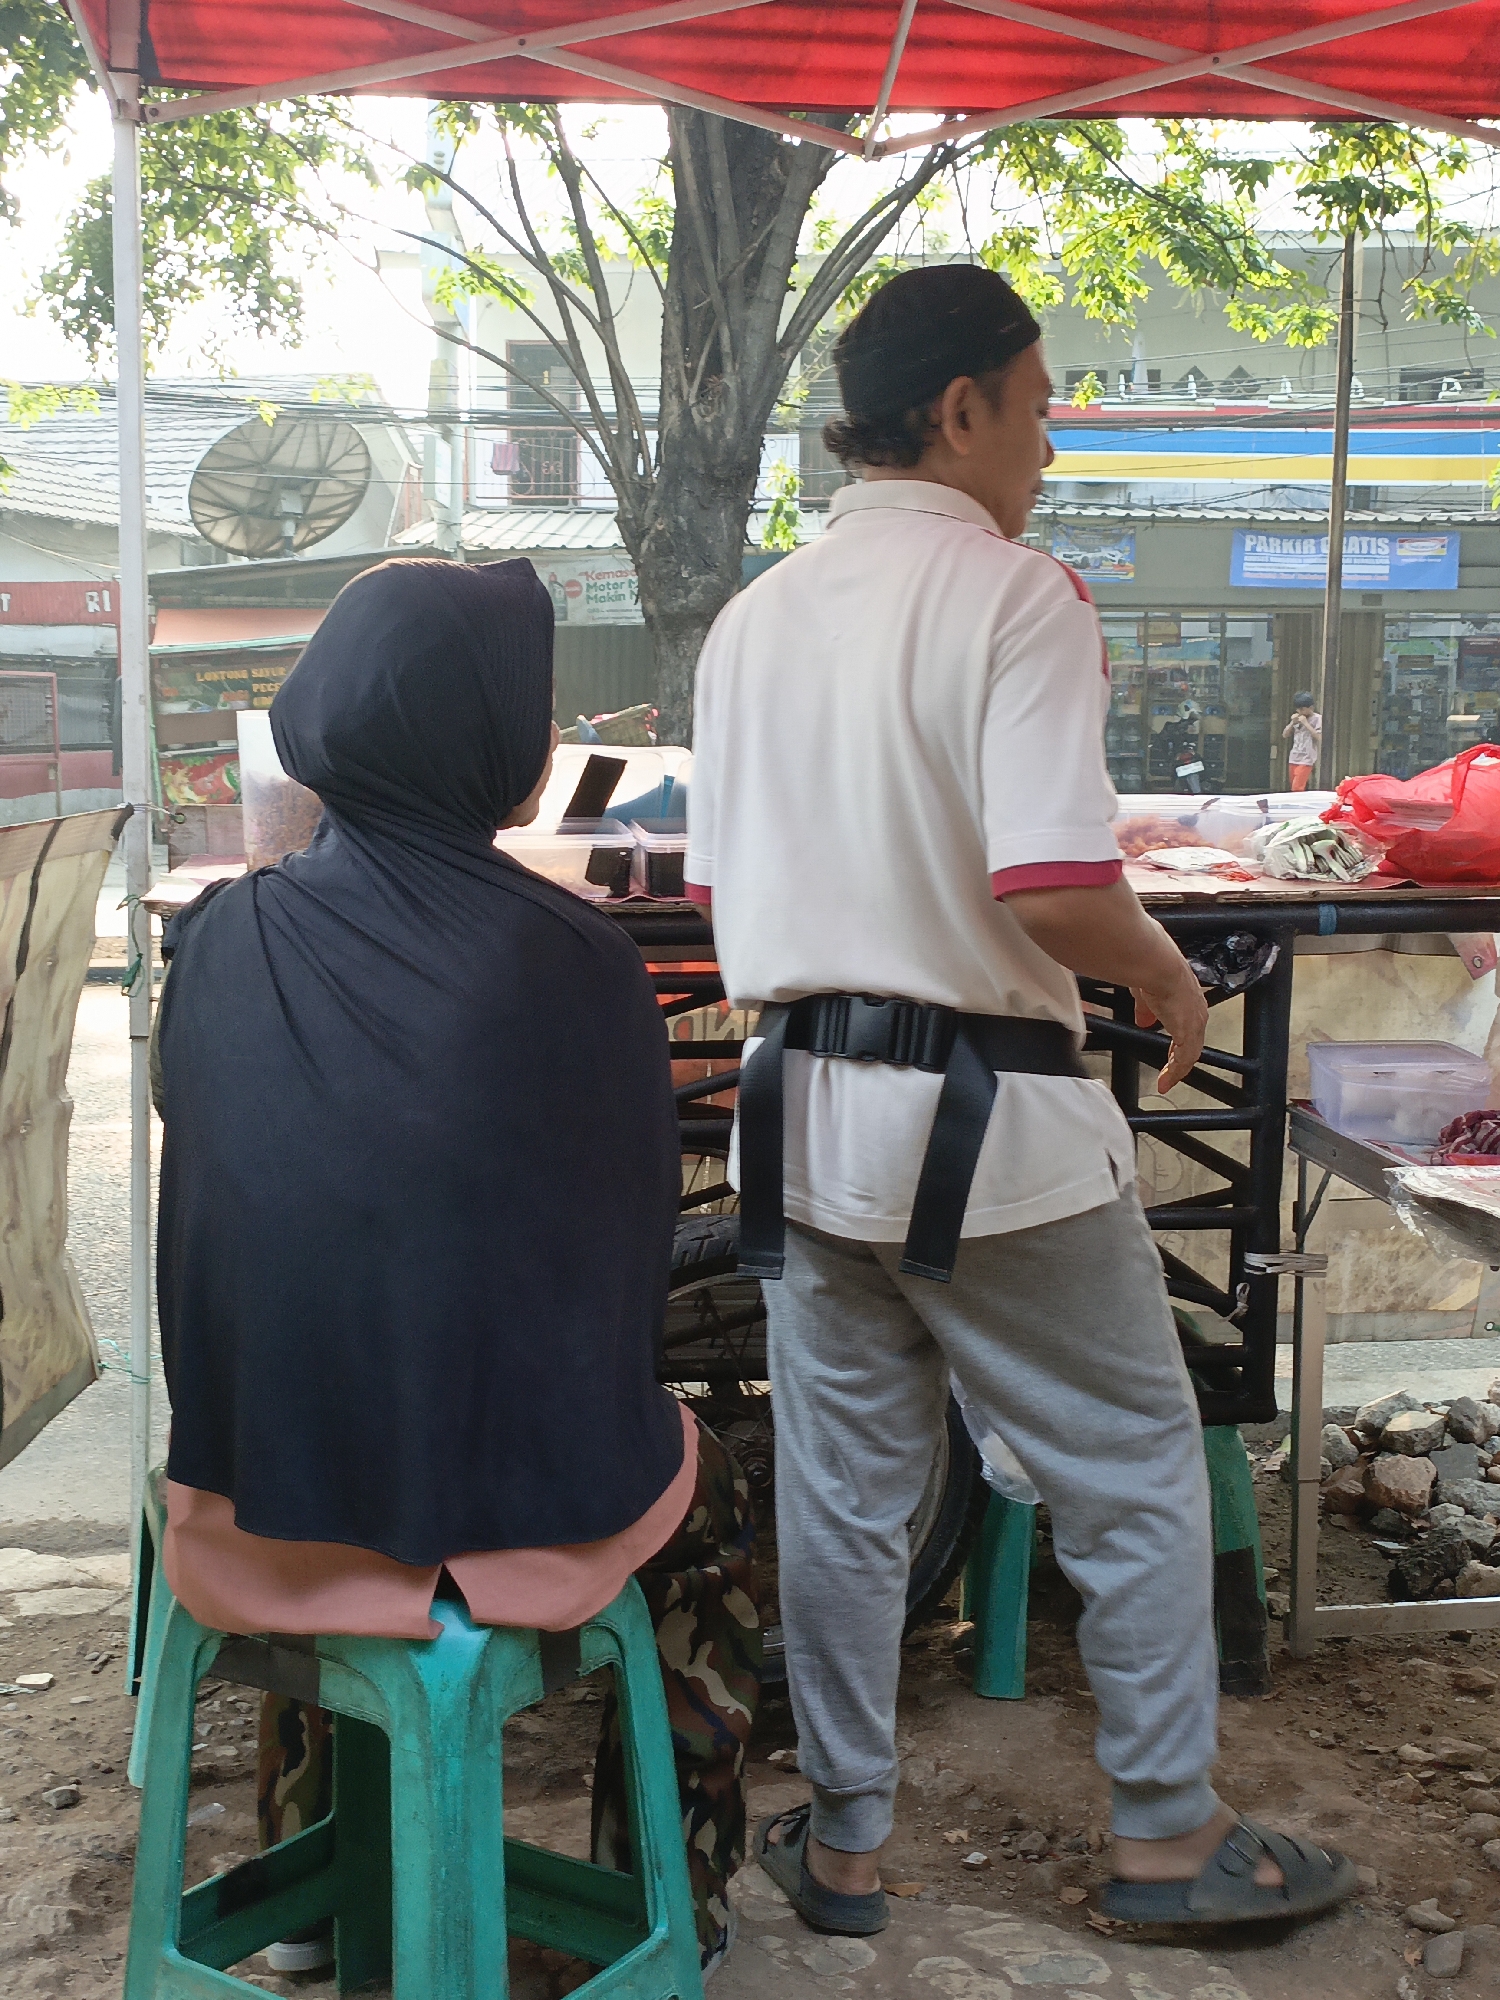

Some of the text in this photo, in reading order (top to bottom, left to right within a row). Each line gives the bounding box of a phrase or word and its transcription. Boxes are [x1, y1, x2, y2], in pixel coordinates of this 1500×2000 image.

[1320, 536, 1389, 554] GATIS
[586, 581, 625, 592] Motor
[586, 591, 626, 604] Makin
